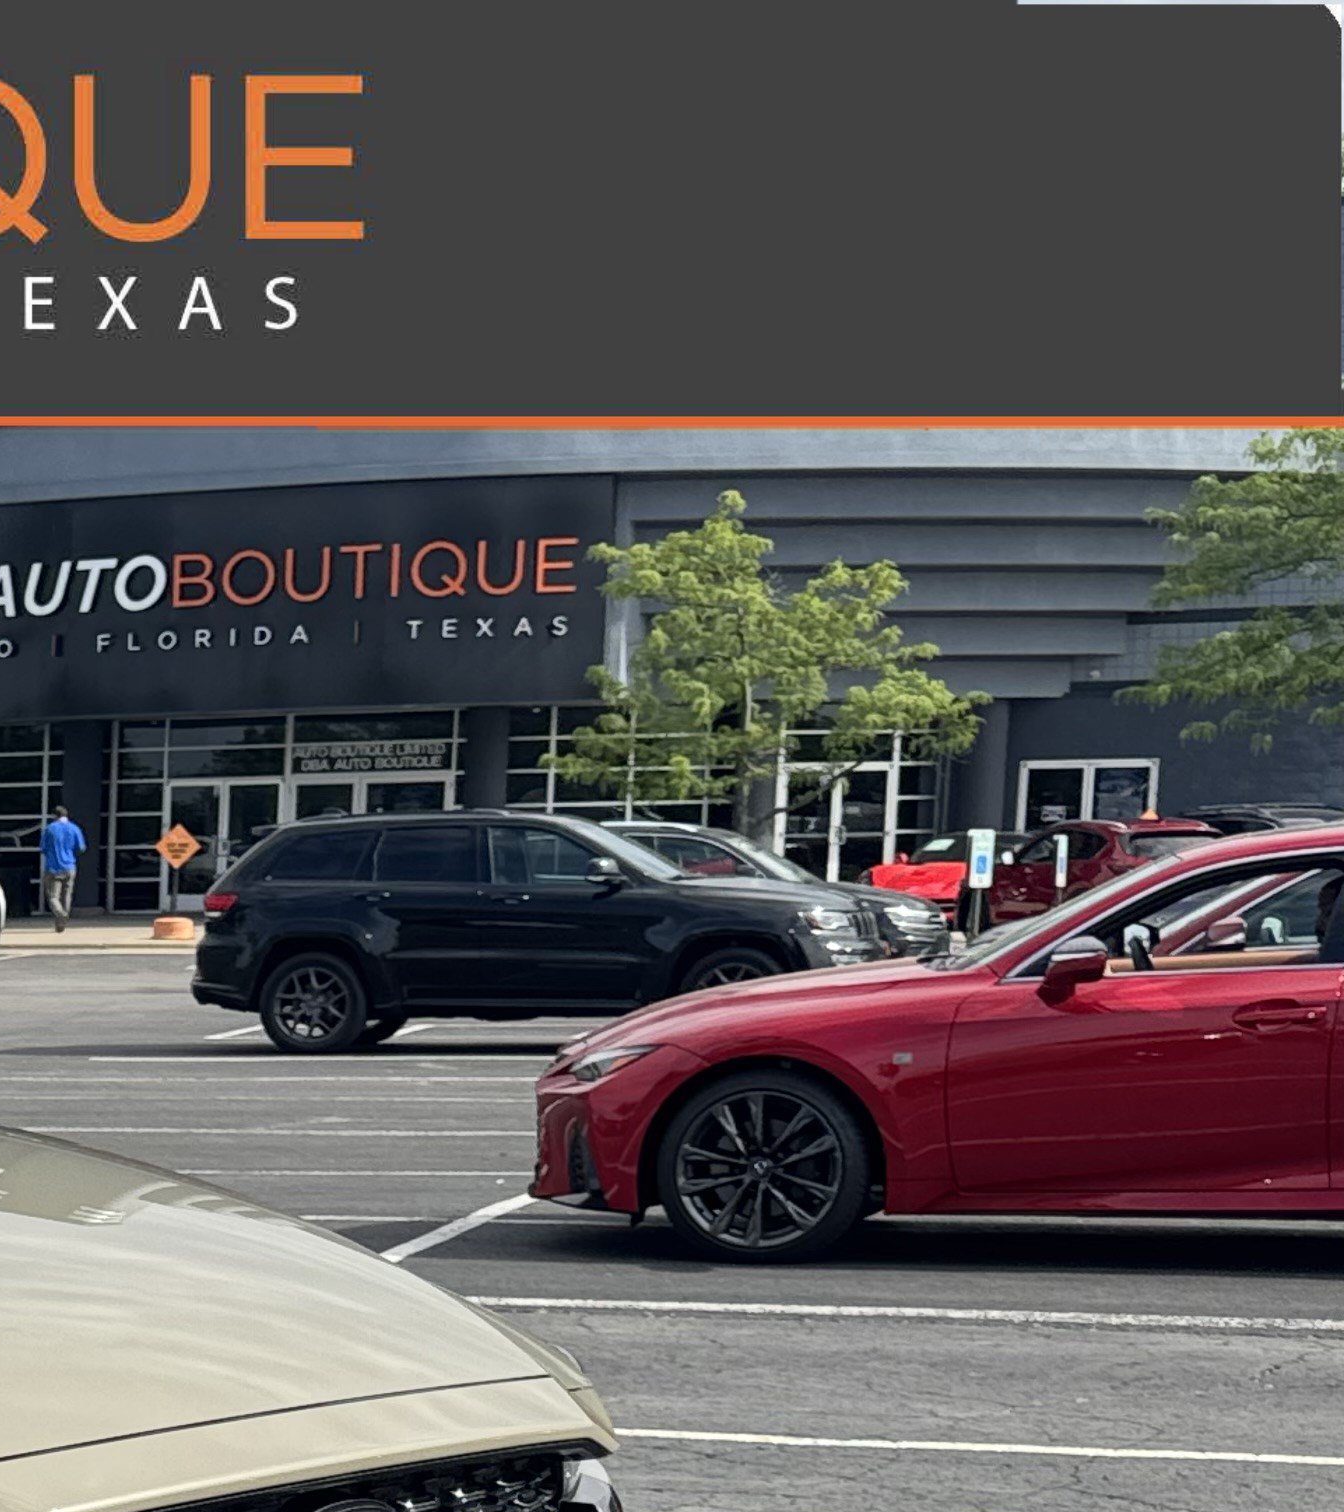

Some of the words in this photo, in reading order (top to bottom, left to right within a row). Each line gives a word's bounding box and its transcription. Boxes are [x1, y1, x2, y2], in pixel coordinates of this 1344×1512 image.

[96, 624, 310, 653] FLORIDA
[407, 615, 569, 639] TEXAS
[333, 757, 372, 770] AUTO
[375, 755, 443, 769] BOUTIQUE
